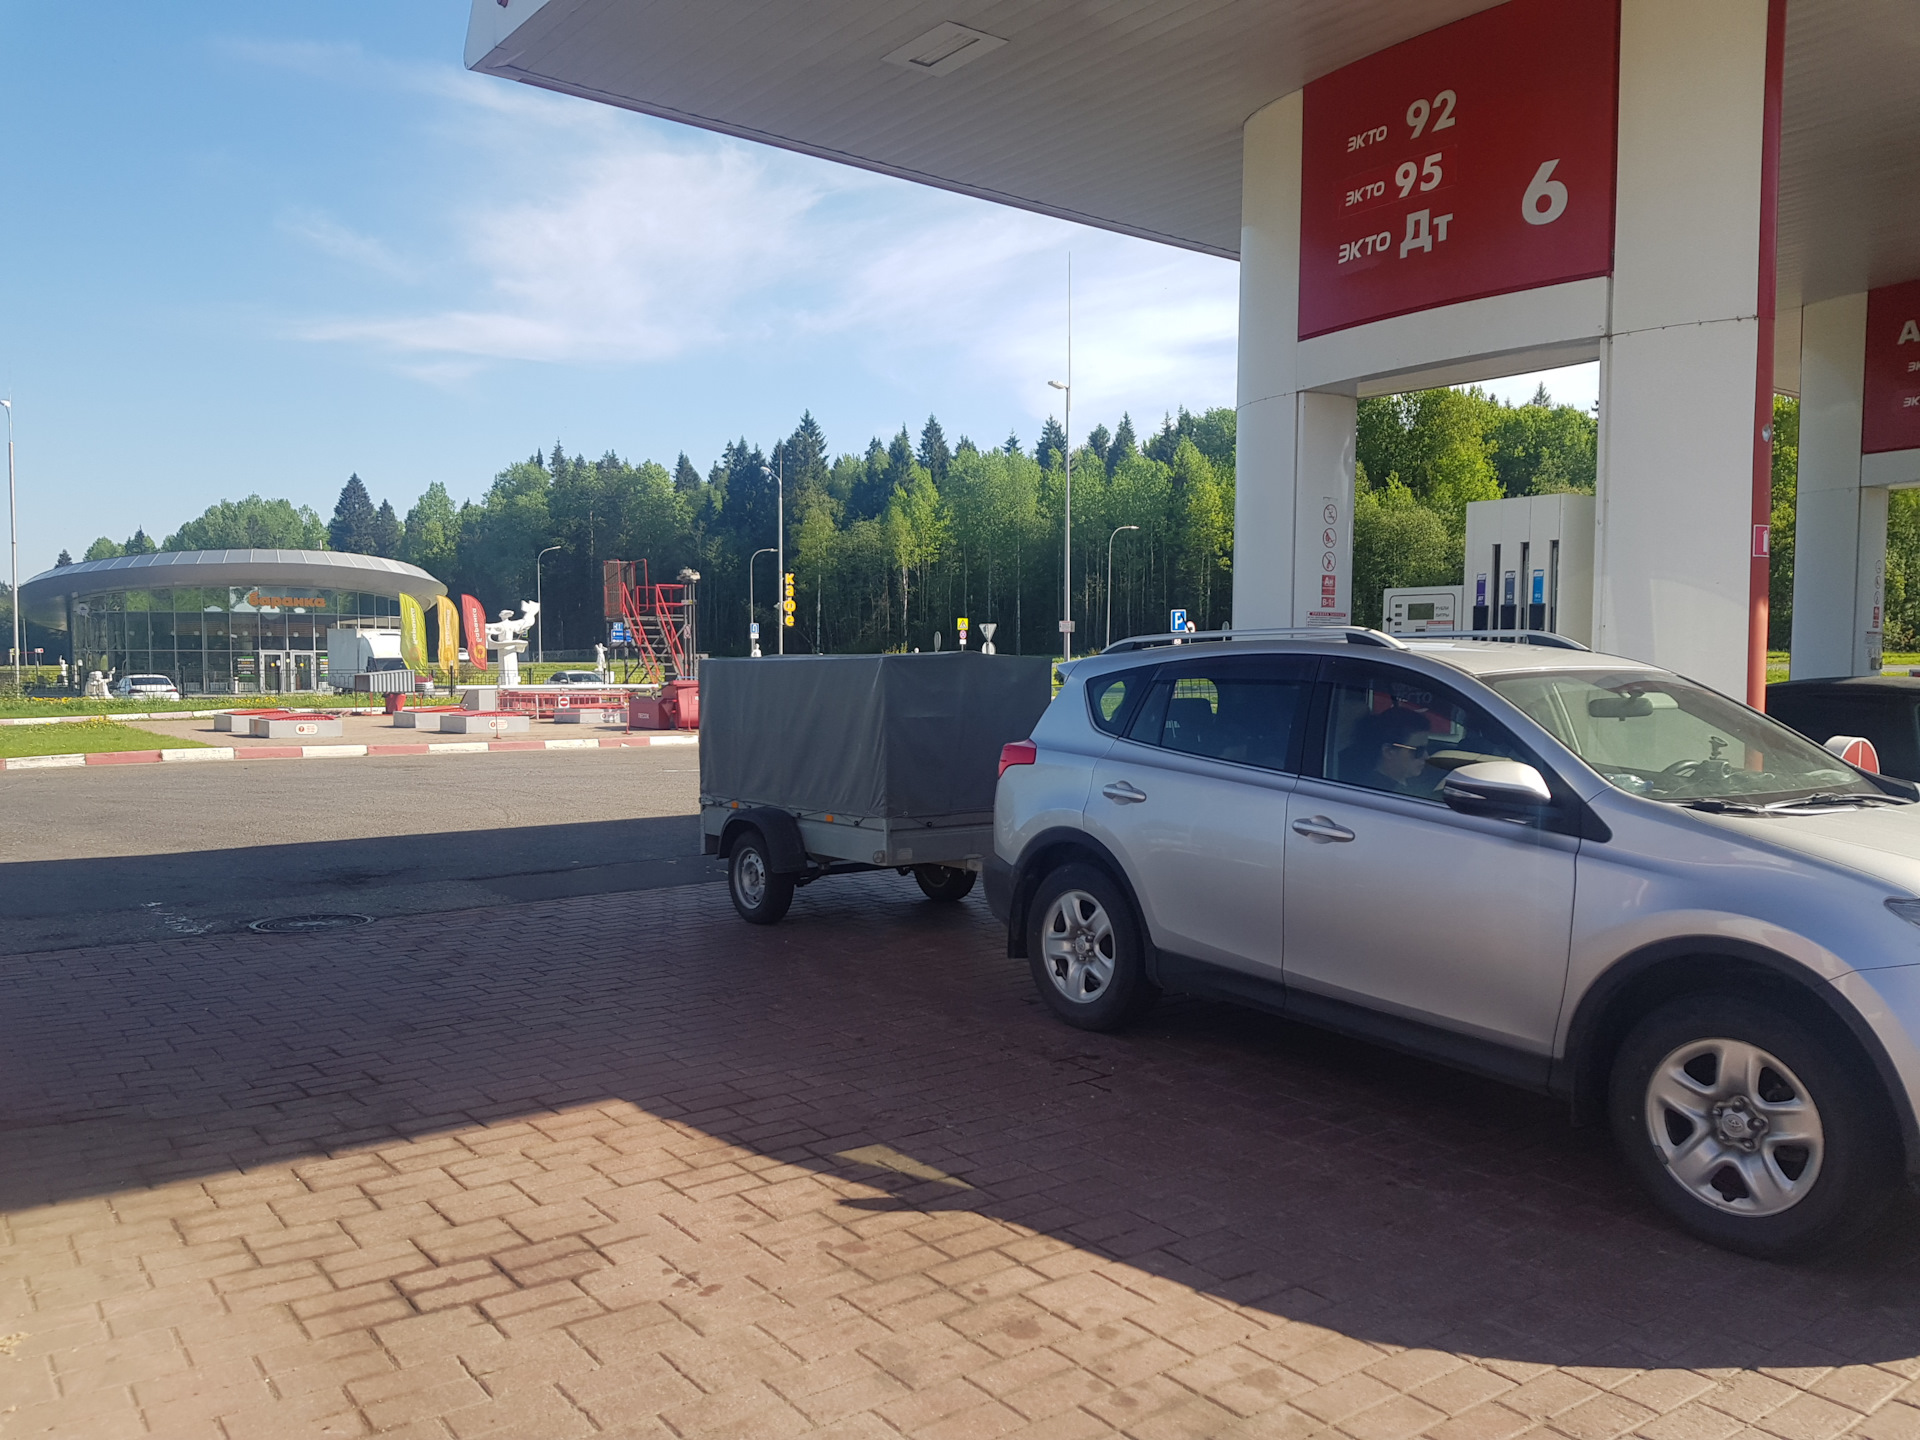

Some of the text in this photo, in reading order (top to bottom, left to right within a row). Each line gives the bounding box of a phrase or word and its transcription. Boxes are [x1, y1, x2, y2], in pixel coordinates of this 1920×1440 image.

[1347, 89, 1457, 152] ЭКТО 92
[1345, 152, 1443, 207] ЭКТО 95
[1521, 158, 1569, 226] 6
[1337, 231, 1392, 264] ЭКТО
[248, 590, 326, 609] баранка
